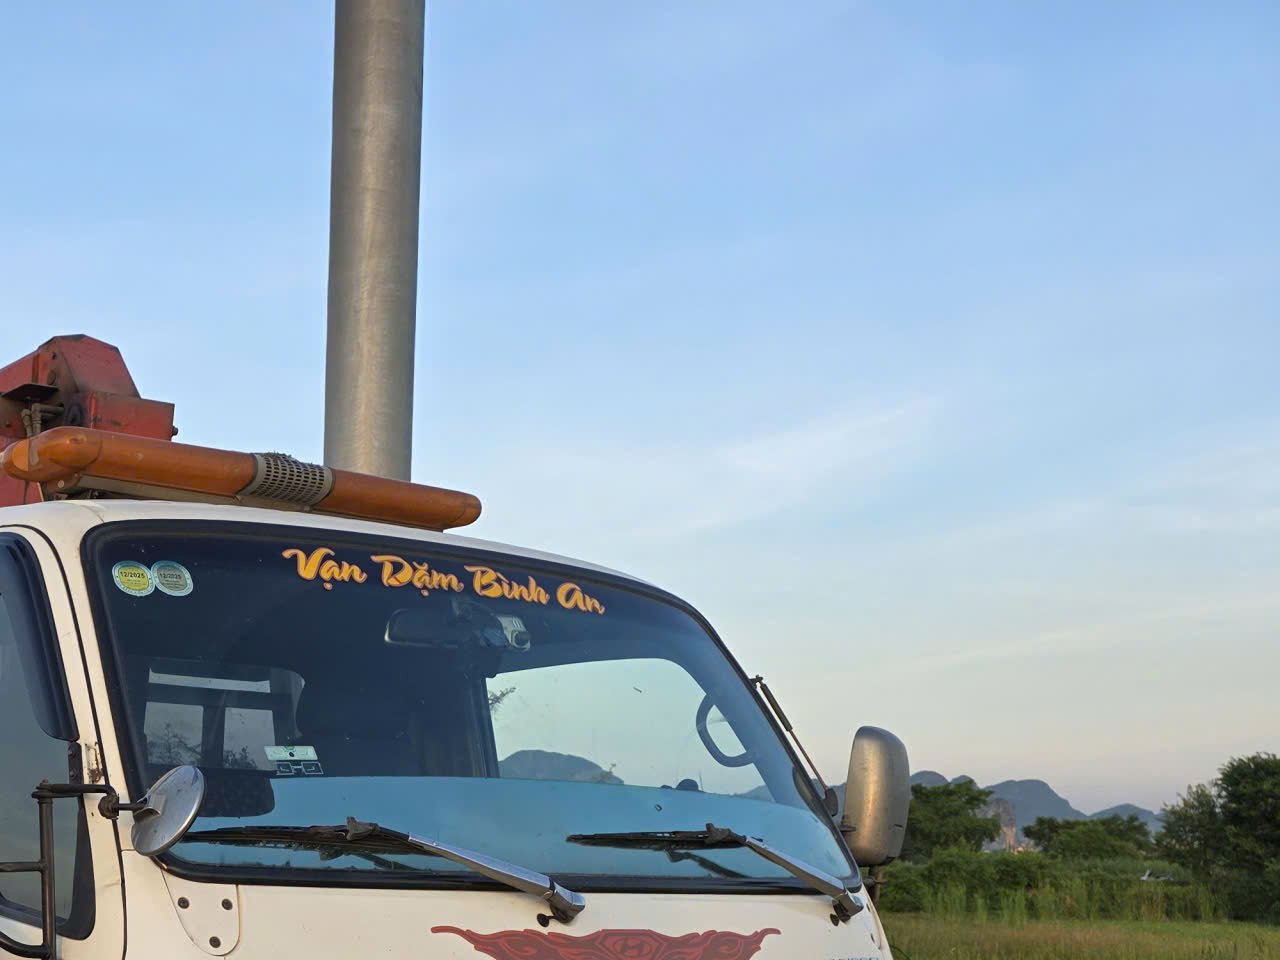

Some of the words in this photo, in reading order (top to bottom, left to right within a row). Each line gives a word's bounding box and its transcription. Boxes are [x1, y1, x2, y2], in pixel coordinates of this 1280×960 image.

[119, 571, 146, 579] 12/2025
[282, 547, 367, 589] Vạn
[370, 554, 464, 597] Dặm
[464, 565, 551, 606] Bình
[556, 581, 606, 615] An
